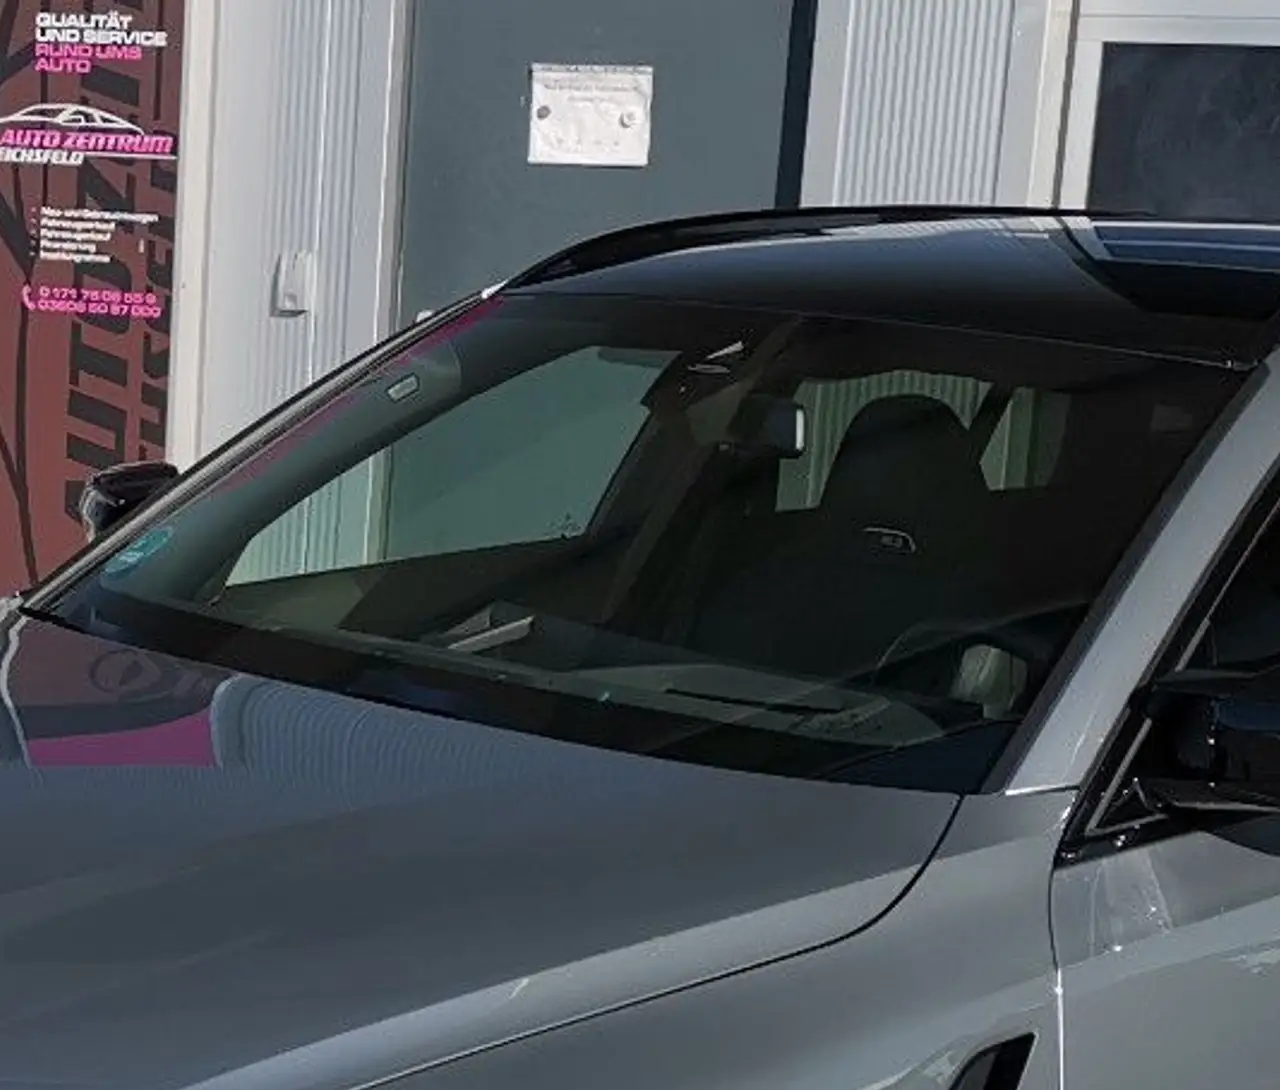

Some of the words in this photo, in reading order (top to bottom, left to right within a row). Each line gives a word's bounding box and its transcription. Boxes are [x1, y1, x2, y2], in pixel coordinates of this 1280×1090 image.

[34, 10, 132, 29] QUALITÄT
[34, 29, 80, 42] UND
[83, 31, 168, 47] SERVICE
[35, 43, 92, 58] RUND
[96, 46, 142, 60] UMS
[35, 58, 91, 73] AUTO
[0, 129, 60, 147] AUTO
[62, 131, 174, 153] ZENTRUM
